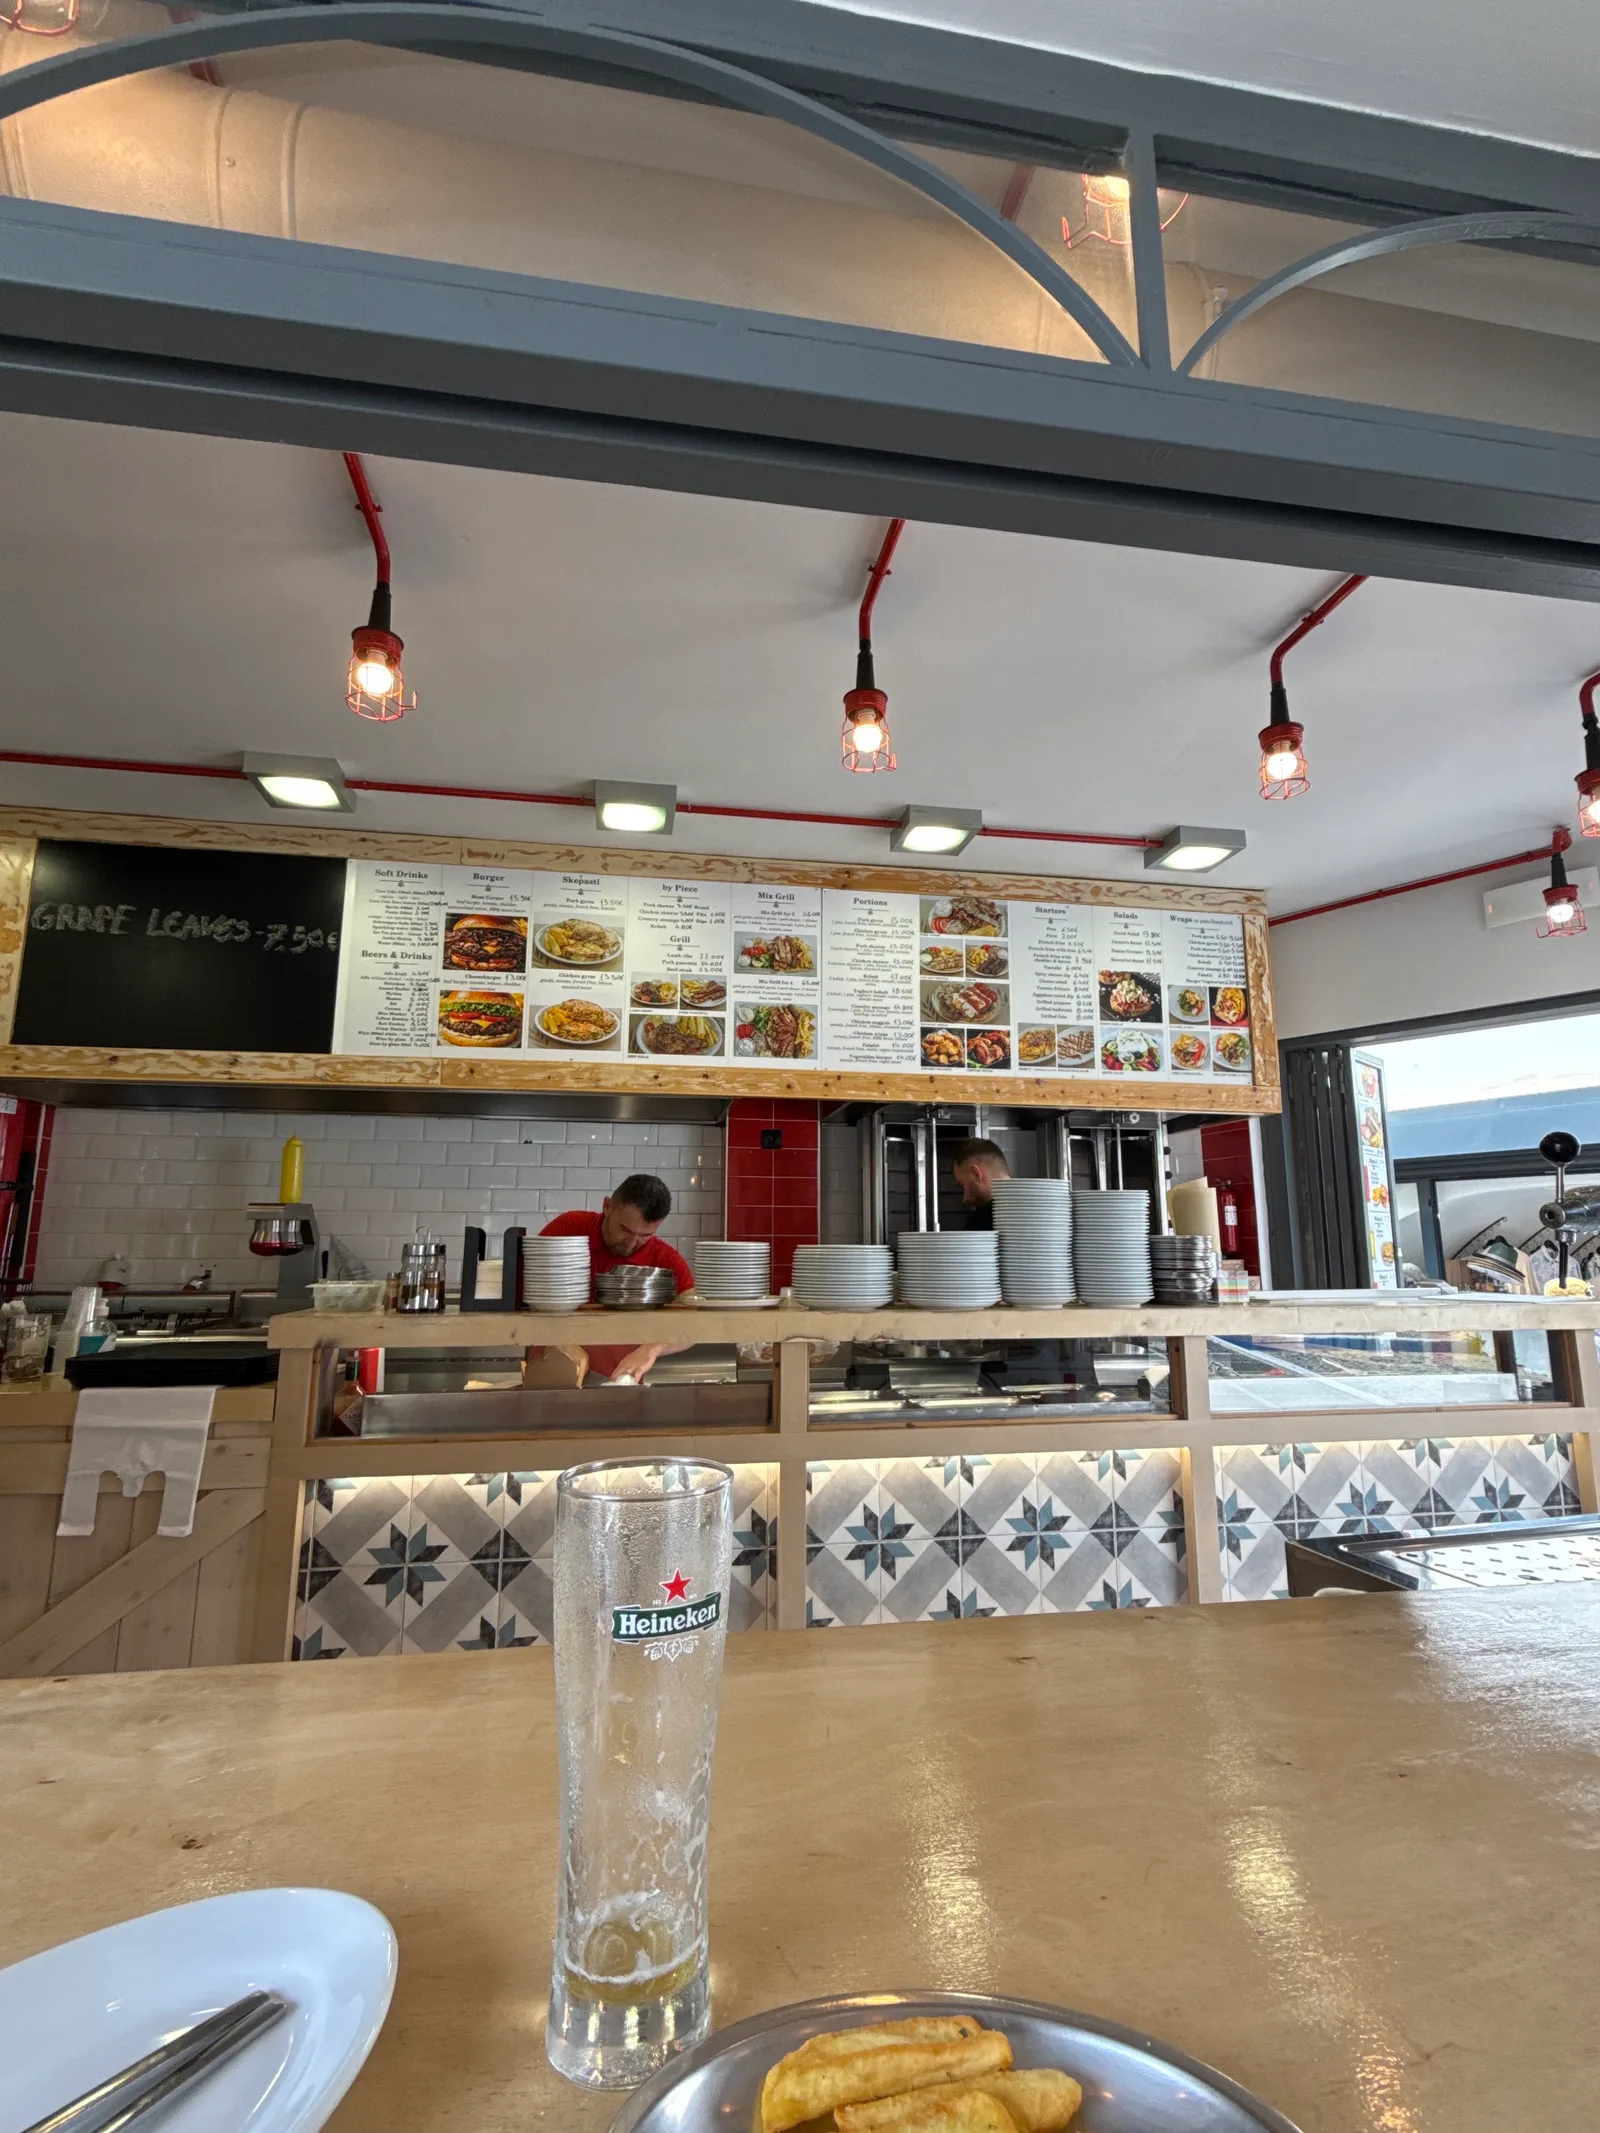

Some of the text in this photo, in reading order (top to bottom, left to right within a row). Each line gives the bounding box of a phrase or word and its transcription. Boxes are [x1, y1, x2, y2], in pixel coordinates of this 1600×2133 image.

[375, 869, 429, 879] Soft Drinks
[473, 873, 506, 882] Burger
[562, 876, 601, 885] Skepasti
[662, 883, 699, 893] by Piece
[758, 892, 795, 901] Mix Grill
[853, 897, 888, 906] Portions
[1035, 906, 1066, 915] Starters
[30, 901, 137, 935] GRAPE
[1113, 911, 1139, 920] Salads
[1170, 915, 1193, 923] Wraps
[670, 935, 691, 943] Grill
[361, 950, 433, 960] Beers & Drinks
[619, 1603, 716, 1635] Heineken
